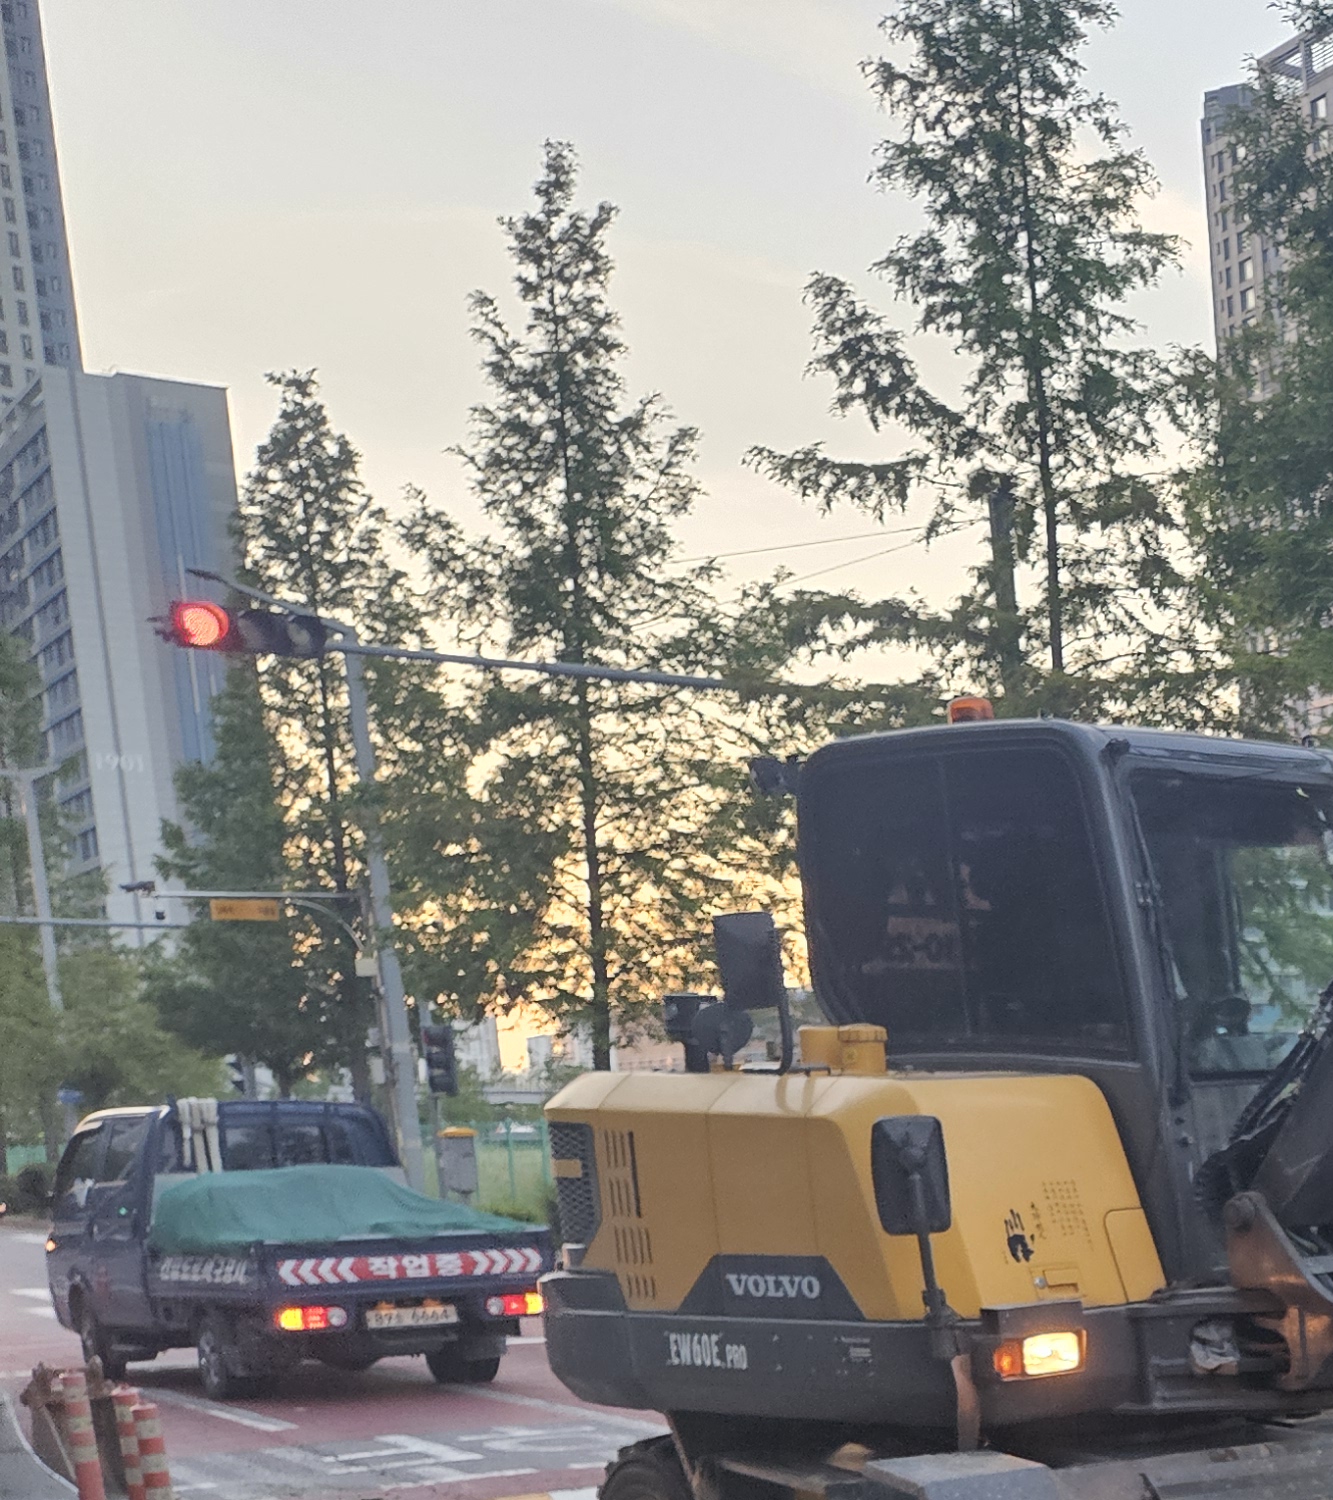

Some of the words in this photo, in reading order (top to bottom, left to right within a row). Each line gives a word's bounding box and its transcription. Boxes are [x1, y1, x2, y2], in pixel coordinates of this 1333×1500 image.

[368, 1253, 461, 1279] 작업중
[726, 1274, 820, 1299] VOLVO
[669, 1332, 720, 1368] EW60E
[726, 1344, 748, 1370] PRO
